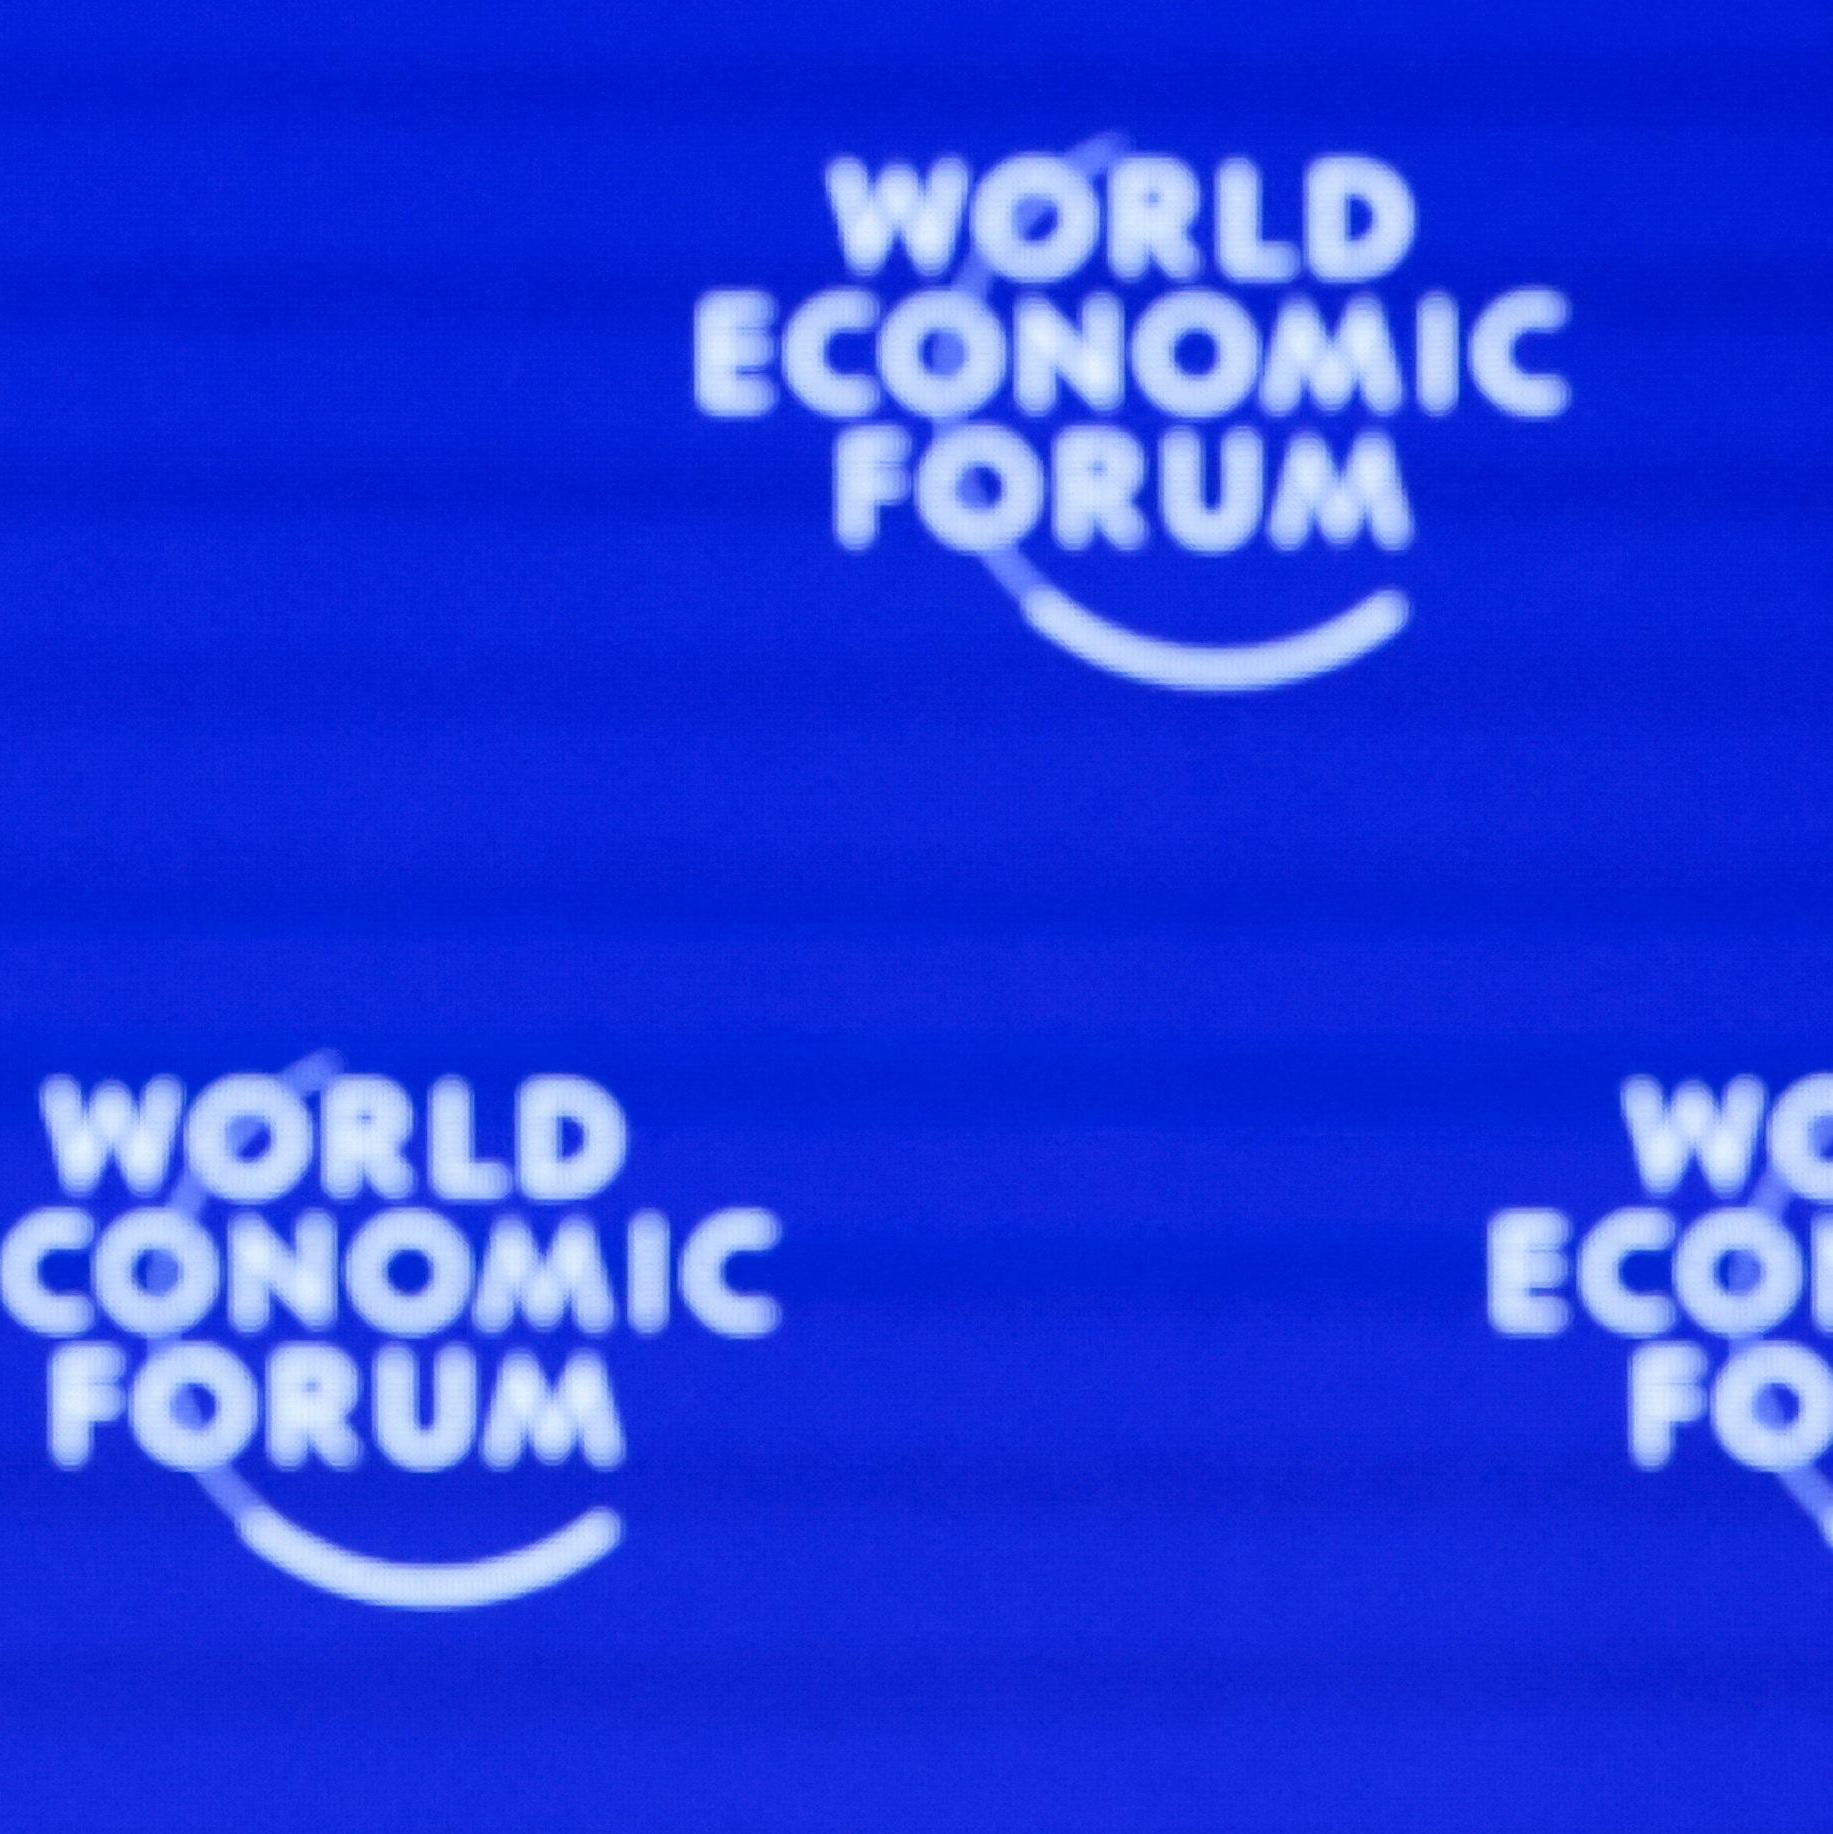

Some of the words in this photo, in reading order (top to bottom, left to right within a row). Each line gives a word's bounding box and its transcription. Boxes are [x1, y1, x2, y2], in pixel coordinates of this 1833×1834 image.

[827, 154, 1416, 283] WORLD
[692, 288, 1564, 422] ECONOMIC
[834, 423, 1410, 554] FORUM
[42, 1073, 628, 1203] WORLD
[1486, 1205, 1833, 1340] ECO
[48, 1339, 623, 1474] FORUM
